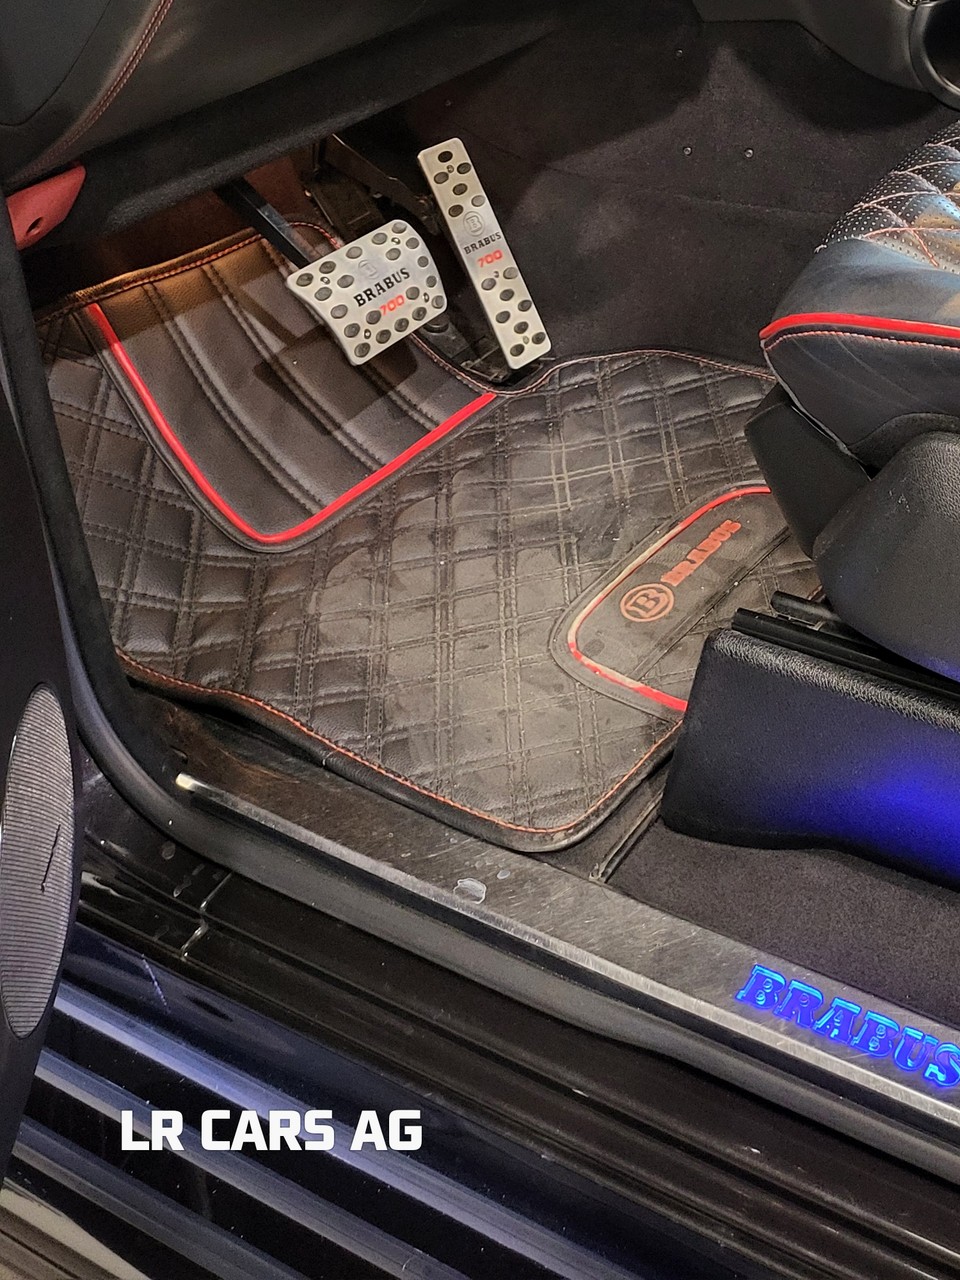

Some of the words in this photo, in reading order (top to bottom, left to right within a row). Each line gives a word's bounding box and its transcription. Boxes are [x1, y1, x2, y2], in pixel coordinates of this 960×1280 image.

[463, 232, 502, 255] BRABUS
[477, 249, 504, 268] 700
[353, 267, 411, 307] BRABUS
[379, 294, 405, 316] 700
